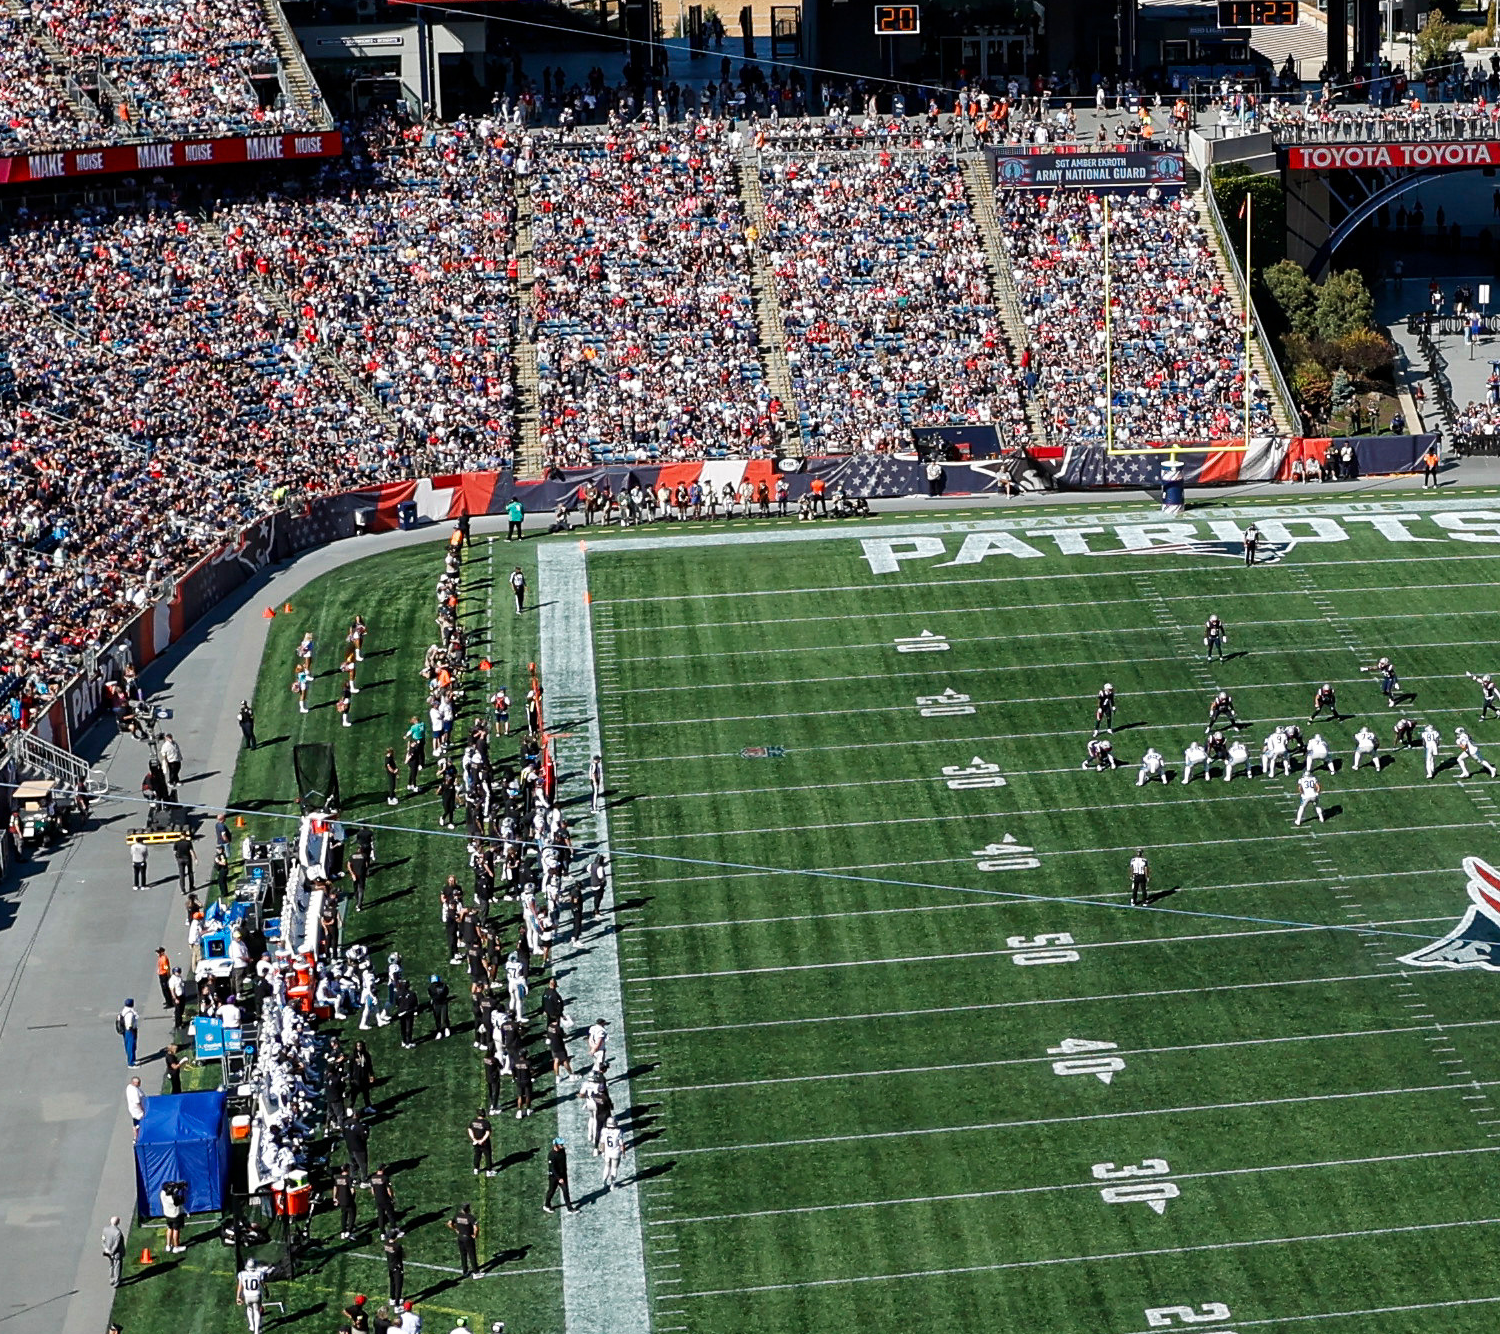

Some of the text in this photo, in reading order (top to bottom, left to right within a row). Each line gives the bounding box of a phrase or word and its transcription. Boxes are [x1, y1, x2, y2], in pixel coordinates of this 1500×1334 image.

[881, 7, 914, 31] 20
[1230, 1, 1295, 25] 11:23
[246, 136, 322, 160] MAKE NOISE
[1299, 146, 1392, 168] TOYOTA
[1401, 145, 1492, 165] TOYOTA
[1035, 167, 1146, 182] ARMY NATIONAL GUARD
[1055, 159, 1069, 168] SGT
[1071, 158, 1096, 167] AMBER
[1006, 932, 1081, 966] 50
[1047, 1038, 1126, 1076] 40
[1091, 1158, 1180, 1204] 30
[244, 1275, 259, 1293] 10
